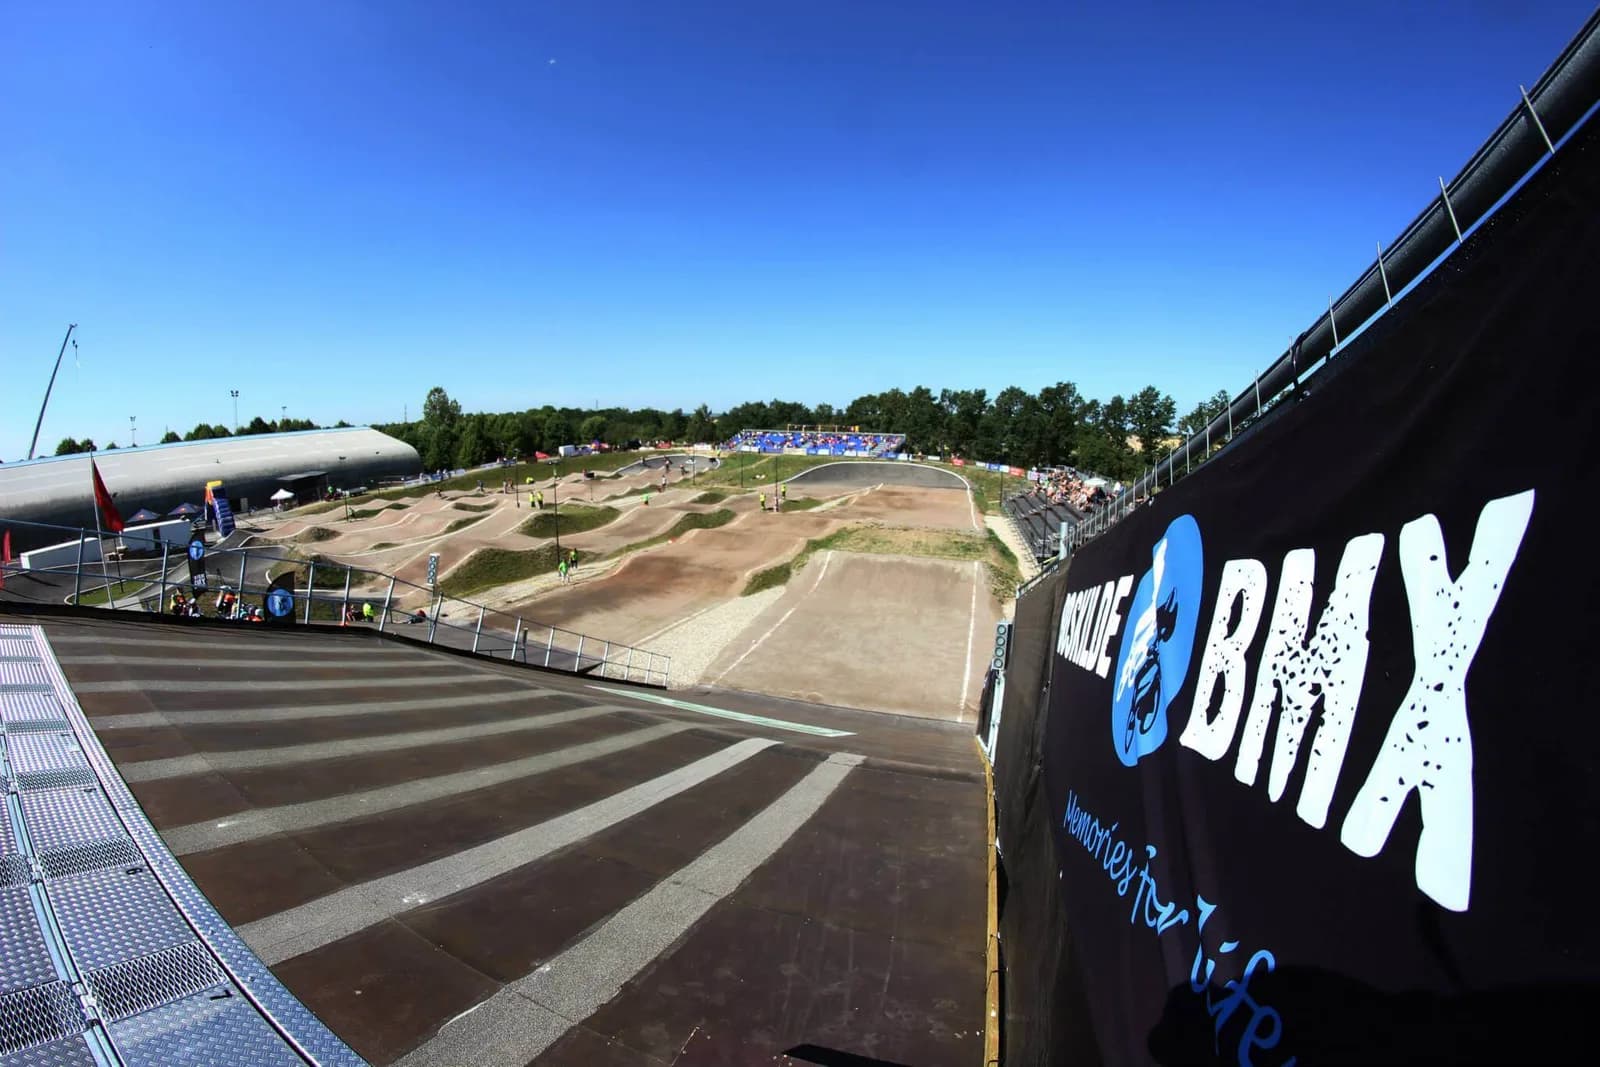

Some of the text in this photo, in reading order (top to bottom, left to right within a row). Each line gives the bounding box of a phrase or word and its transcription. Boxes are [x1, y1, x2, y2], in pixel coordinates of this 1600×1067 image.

[1179, 488, 1535, 912] BMX
[1063, 789, 1138, 897] Memories
[1130, 844, 1190, 936] for
[209, 989, 234, 1001] 7
